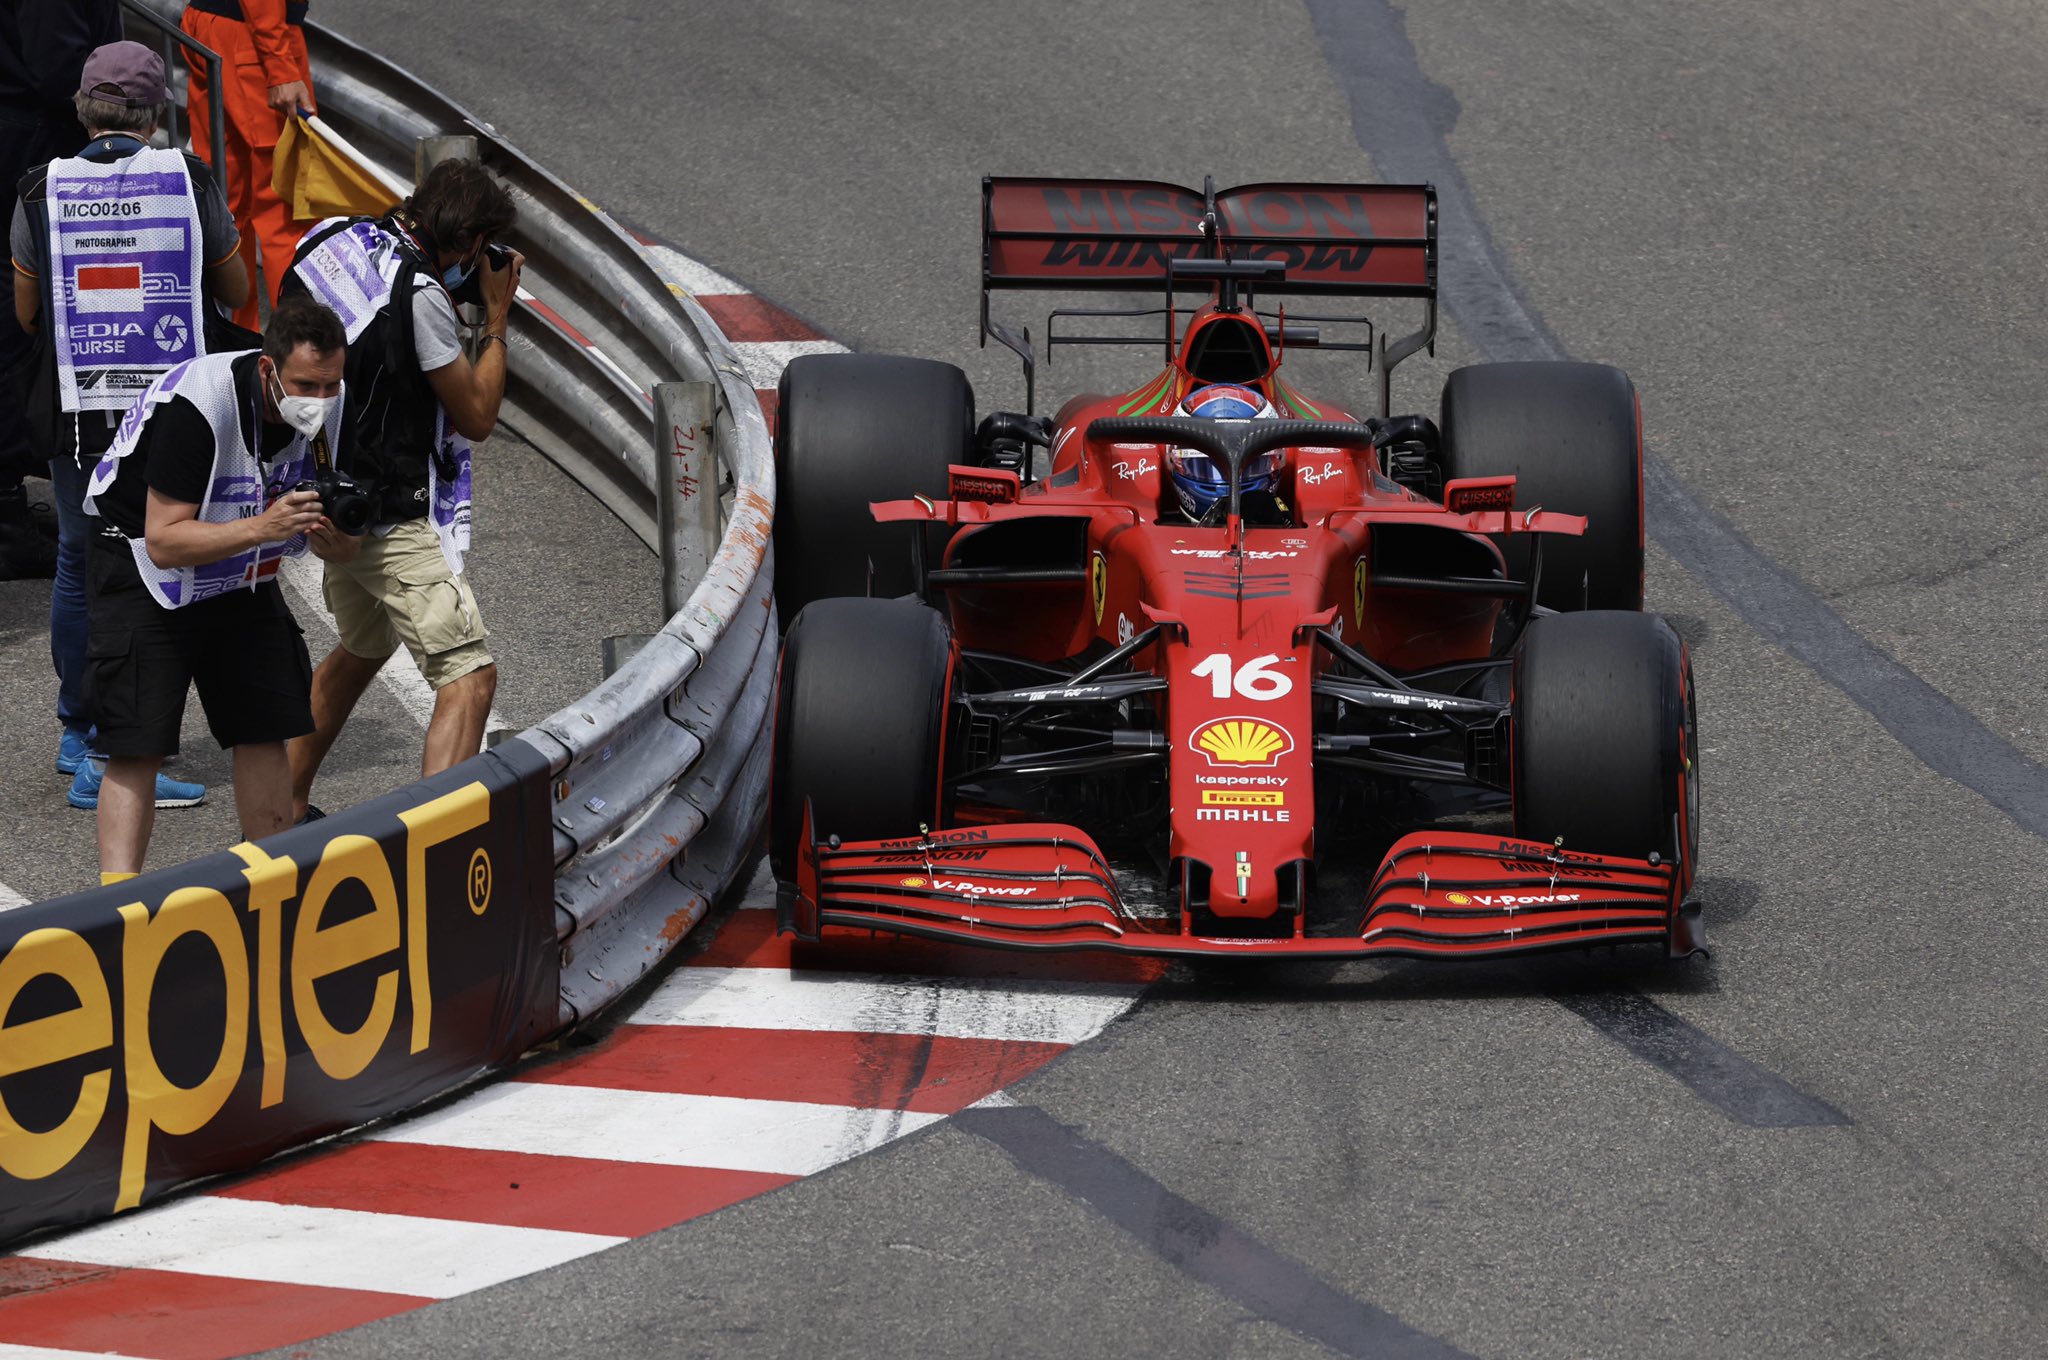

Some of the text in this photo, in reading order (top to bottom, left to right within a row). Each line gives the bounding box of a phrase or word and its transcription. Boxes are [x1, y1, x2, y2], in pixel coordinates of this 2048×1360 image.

[63, 202, 142, 218] MCO0206
[1041, 187, 1376, 238] MISSION
[75, 237, 137, 249] PHOTOGRAPHER
[58, 322, 146, 339] EDIA
[1111, 457, 1158, 481] Ray-Ban
[1297, 461, 1343, 485] Ray-Ban
[1191, 652, 1293, 701] 16
[1195, 774, 1289, 787] kaspersky
[1196, 808, 1290, 822] MAHLE
[1498, 840, 1604, 863] MISSON
[932, 879, 1037, 896] V-Power
[1472, 892, 1580, 906] V-Power
